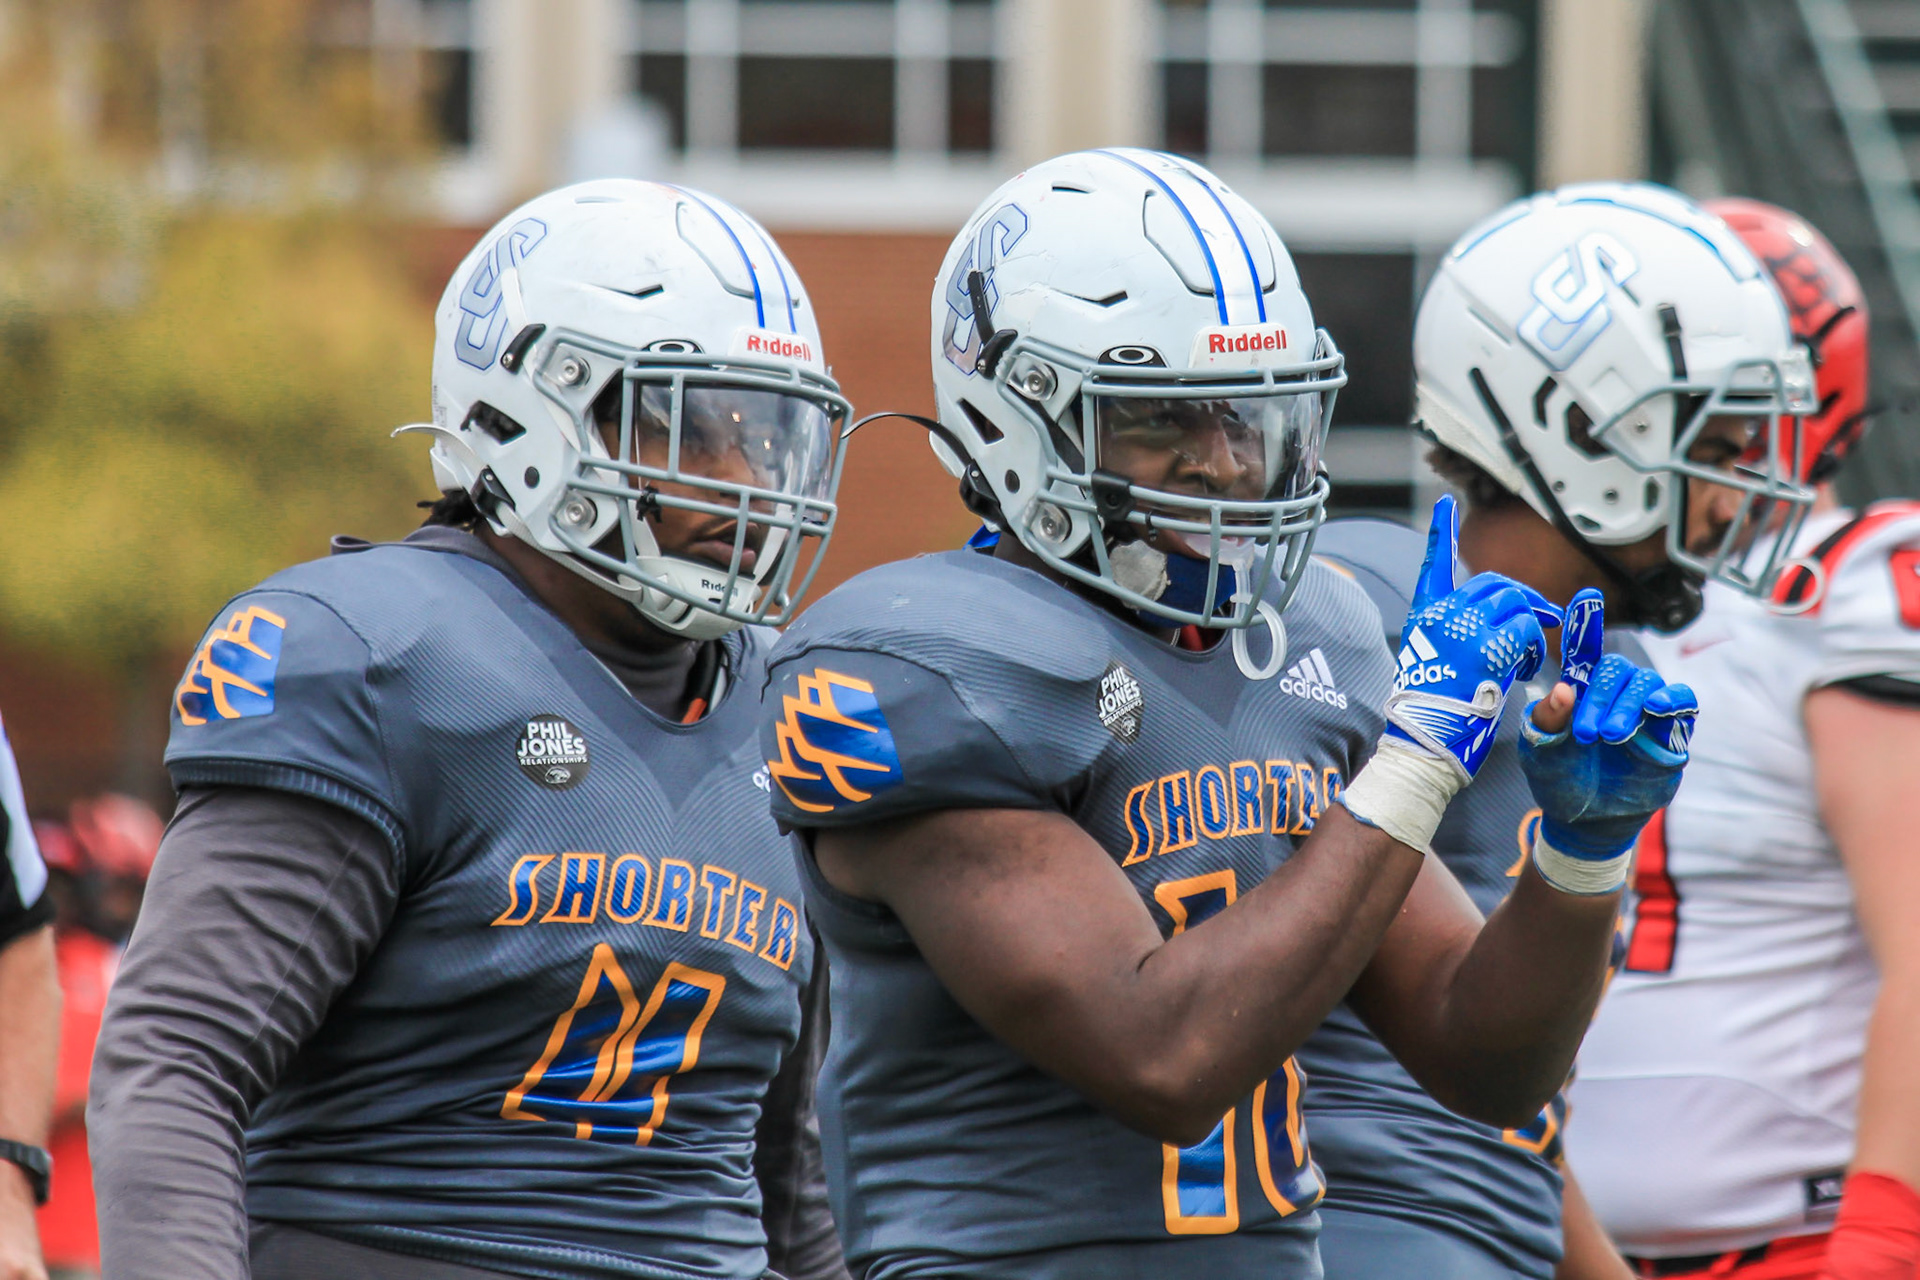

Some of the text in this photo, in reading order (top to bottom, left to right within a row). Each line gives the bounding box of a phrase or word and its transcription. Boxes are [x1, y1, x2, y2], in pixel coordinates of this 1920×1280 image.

[747, 334, 812, 362] Riddell
[1208, 329, 1287, 354] Riddell
[1101, 667, 1130, 697] PHIL
[1393, 662, 1457, 691] didas
[1099, 680, 1140, 719] JONES
[1279, 677, 1349, 710] adidas
[527, 722, 573, 740] PHIL
[517, 737, 586, 757] JONES
[520, 756, 588, 766] RELATIONSHIPS
[490, 852, 799, 971] SHORTER
